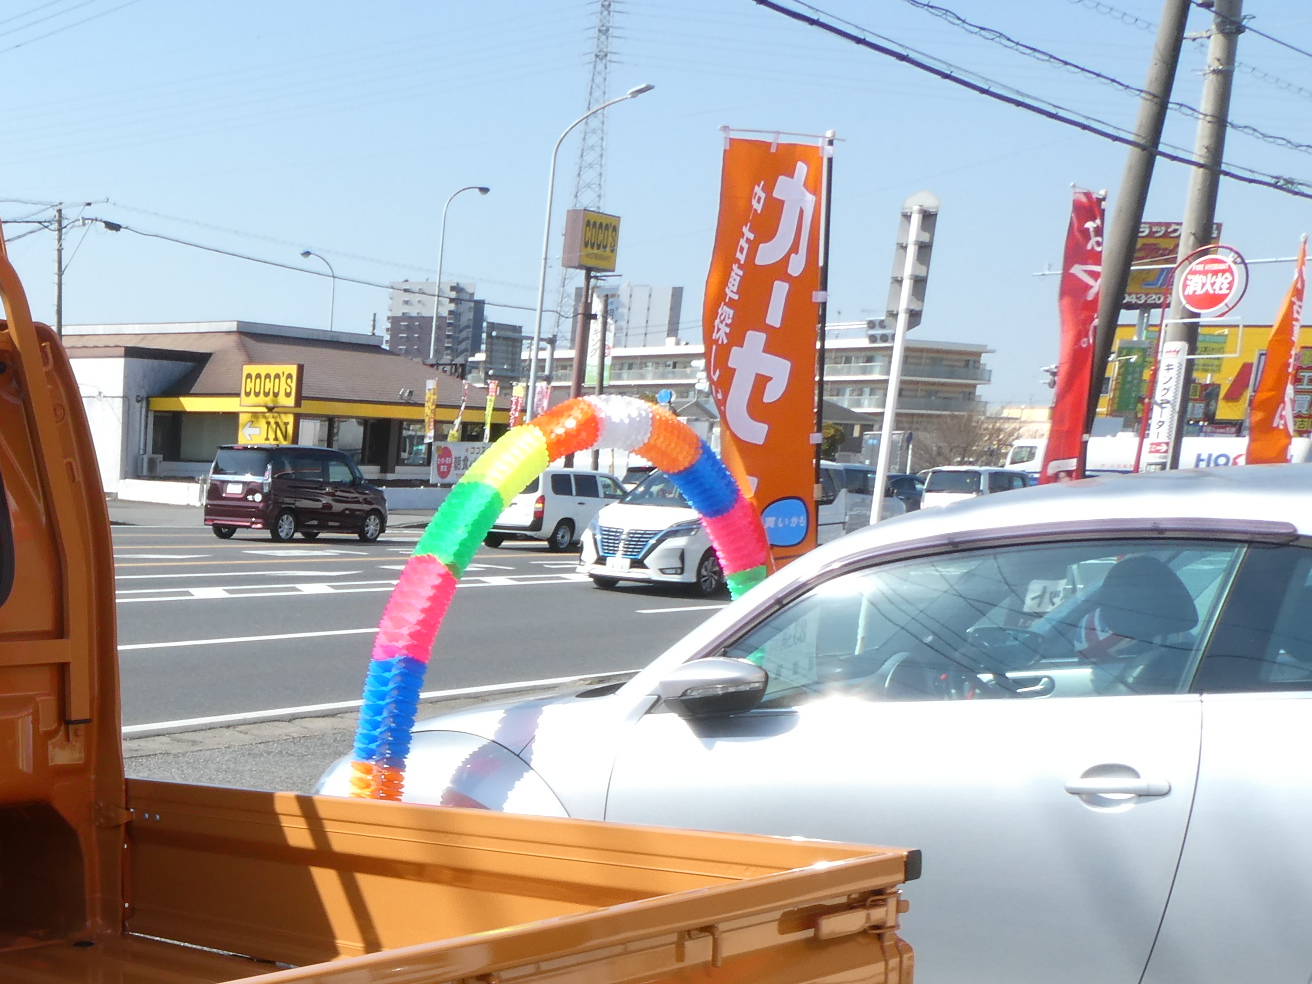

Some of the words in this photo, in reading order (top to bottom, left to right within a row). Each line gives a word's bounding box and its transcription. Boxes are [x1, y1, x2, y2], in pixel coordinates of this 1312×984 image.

[584, 219, 617, 253] COCO'S
[1184, 273, 1233, 295] 消火栓
[244, 371, 293, 398] COCO'S
[264, 420, 290, 441] IN
